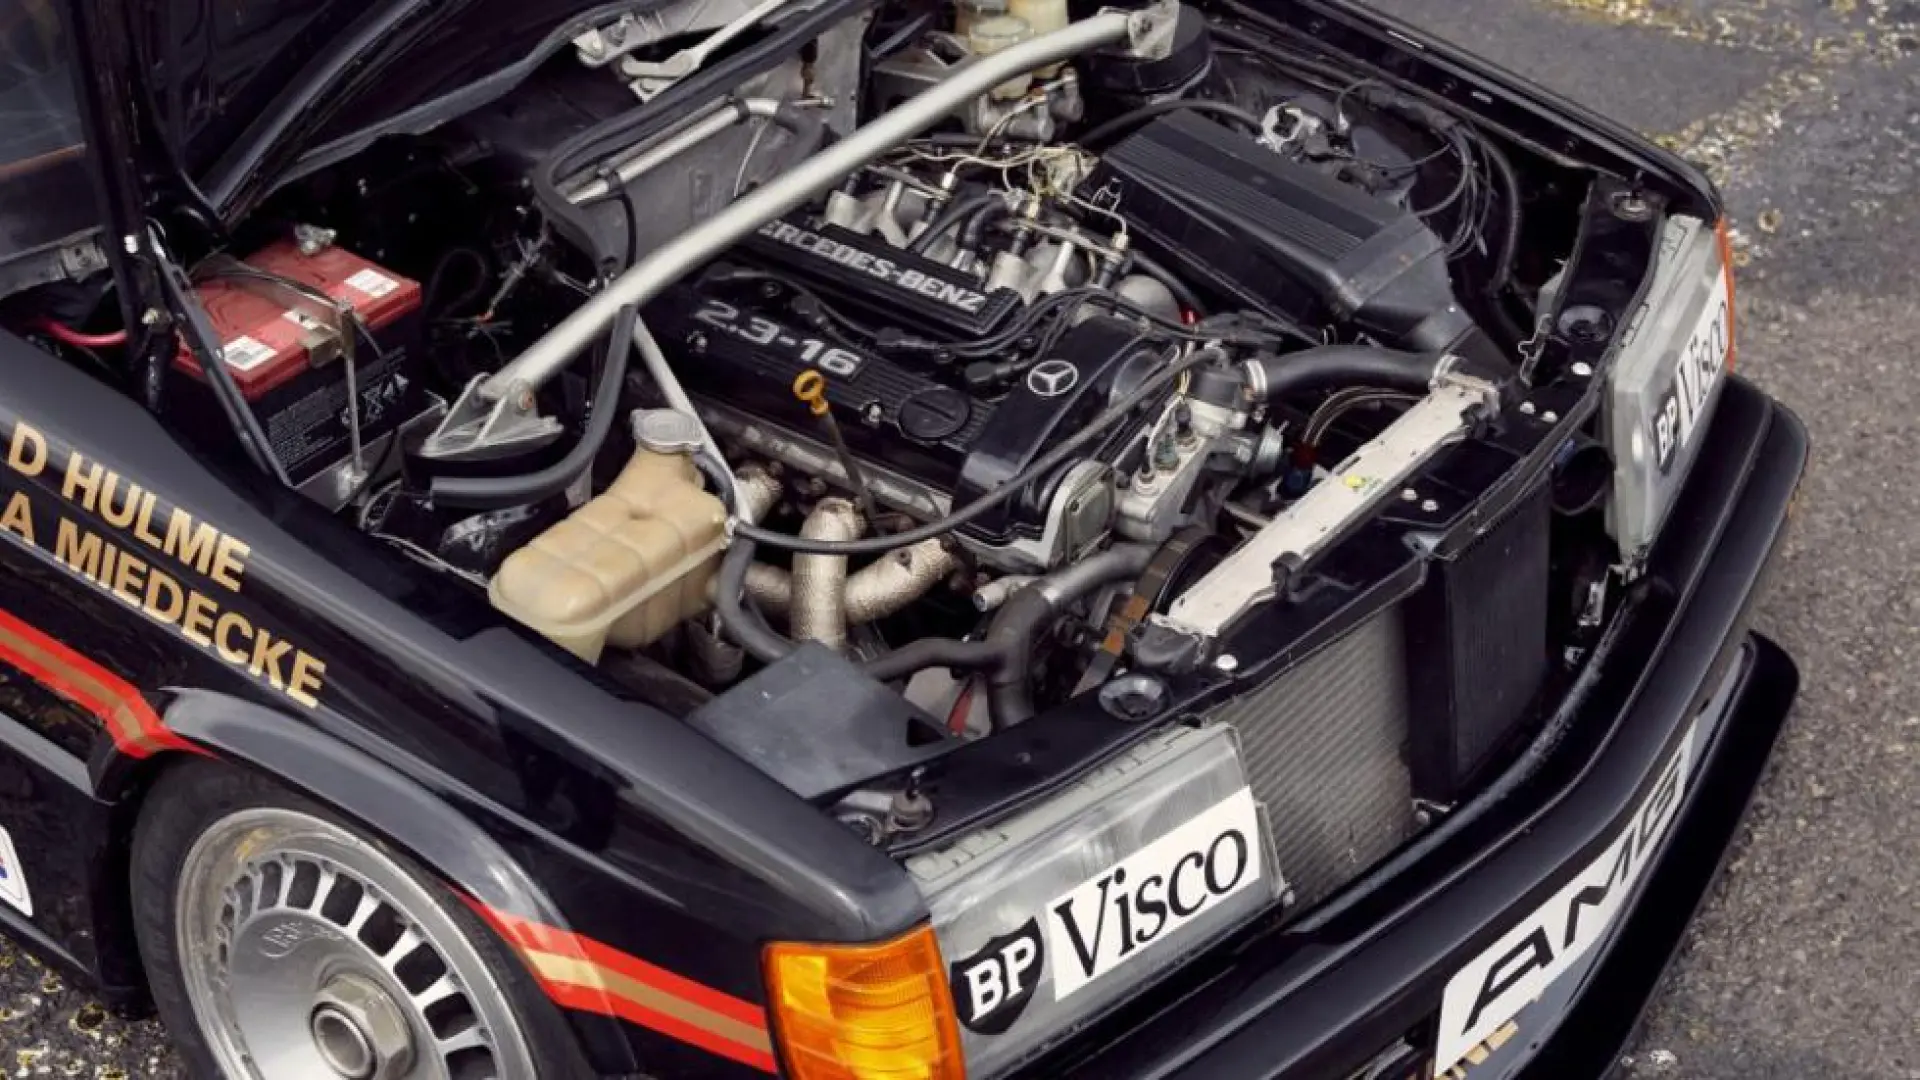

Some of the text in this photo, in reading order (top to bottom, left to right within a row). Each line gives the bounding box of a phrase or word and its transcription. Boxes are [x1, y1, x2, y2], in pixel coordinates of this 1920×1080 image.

[695, 299, 862, 375] 2.3-16
[757, 218, 986, 313] ERCEDES-BENZ
[8, 421, 250, 592] D HULME
[1656, 396, 1678, 466] BP
[0, 491, 326, 709] A MIEDECKE
[963, 828, 1248, 1003] BP Visco
[1461, 749, 1682, 1037] AMG
